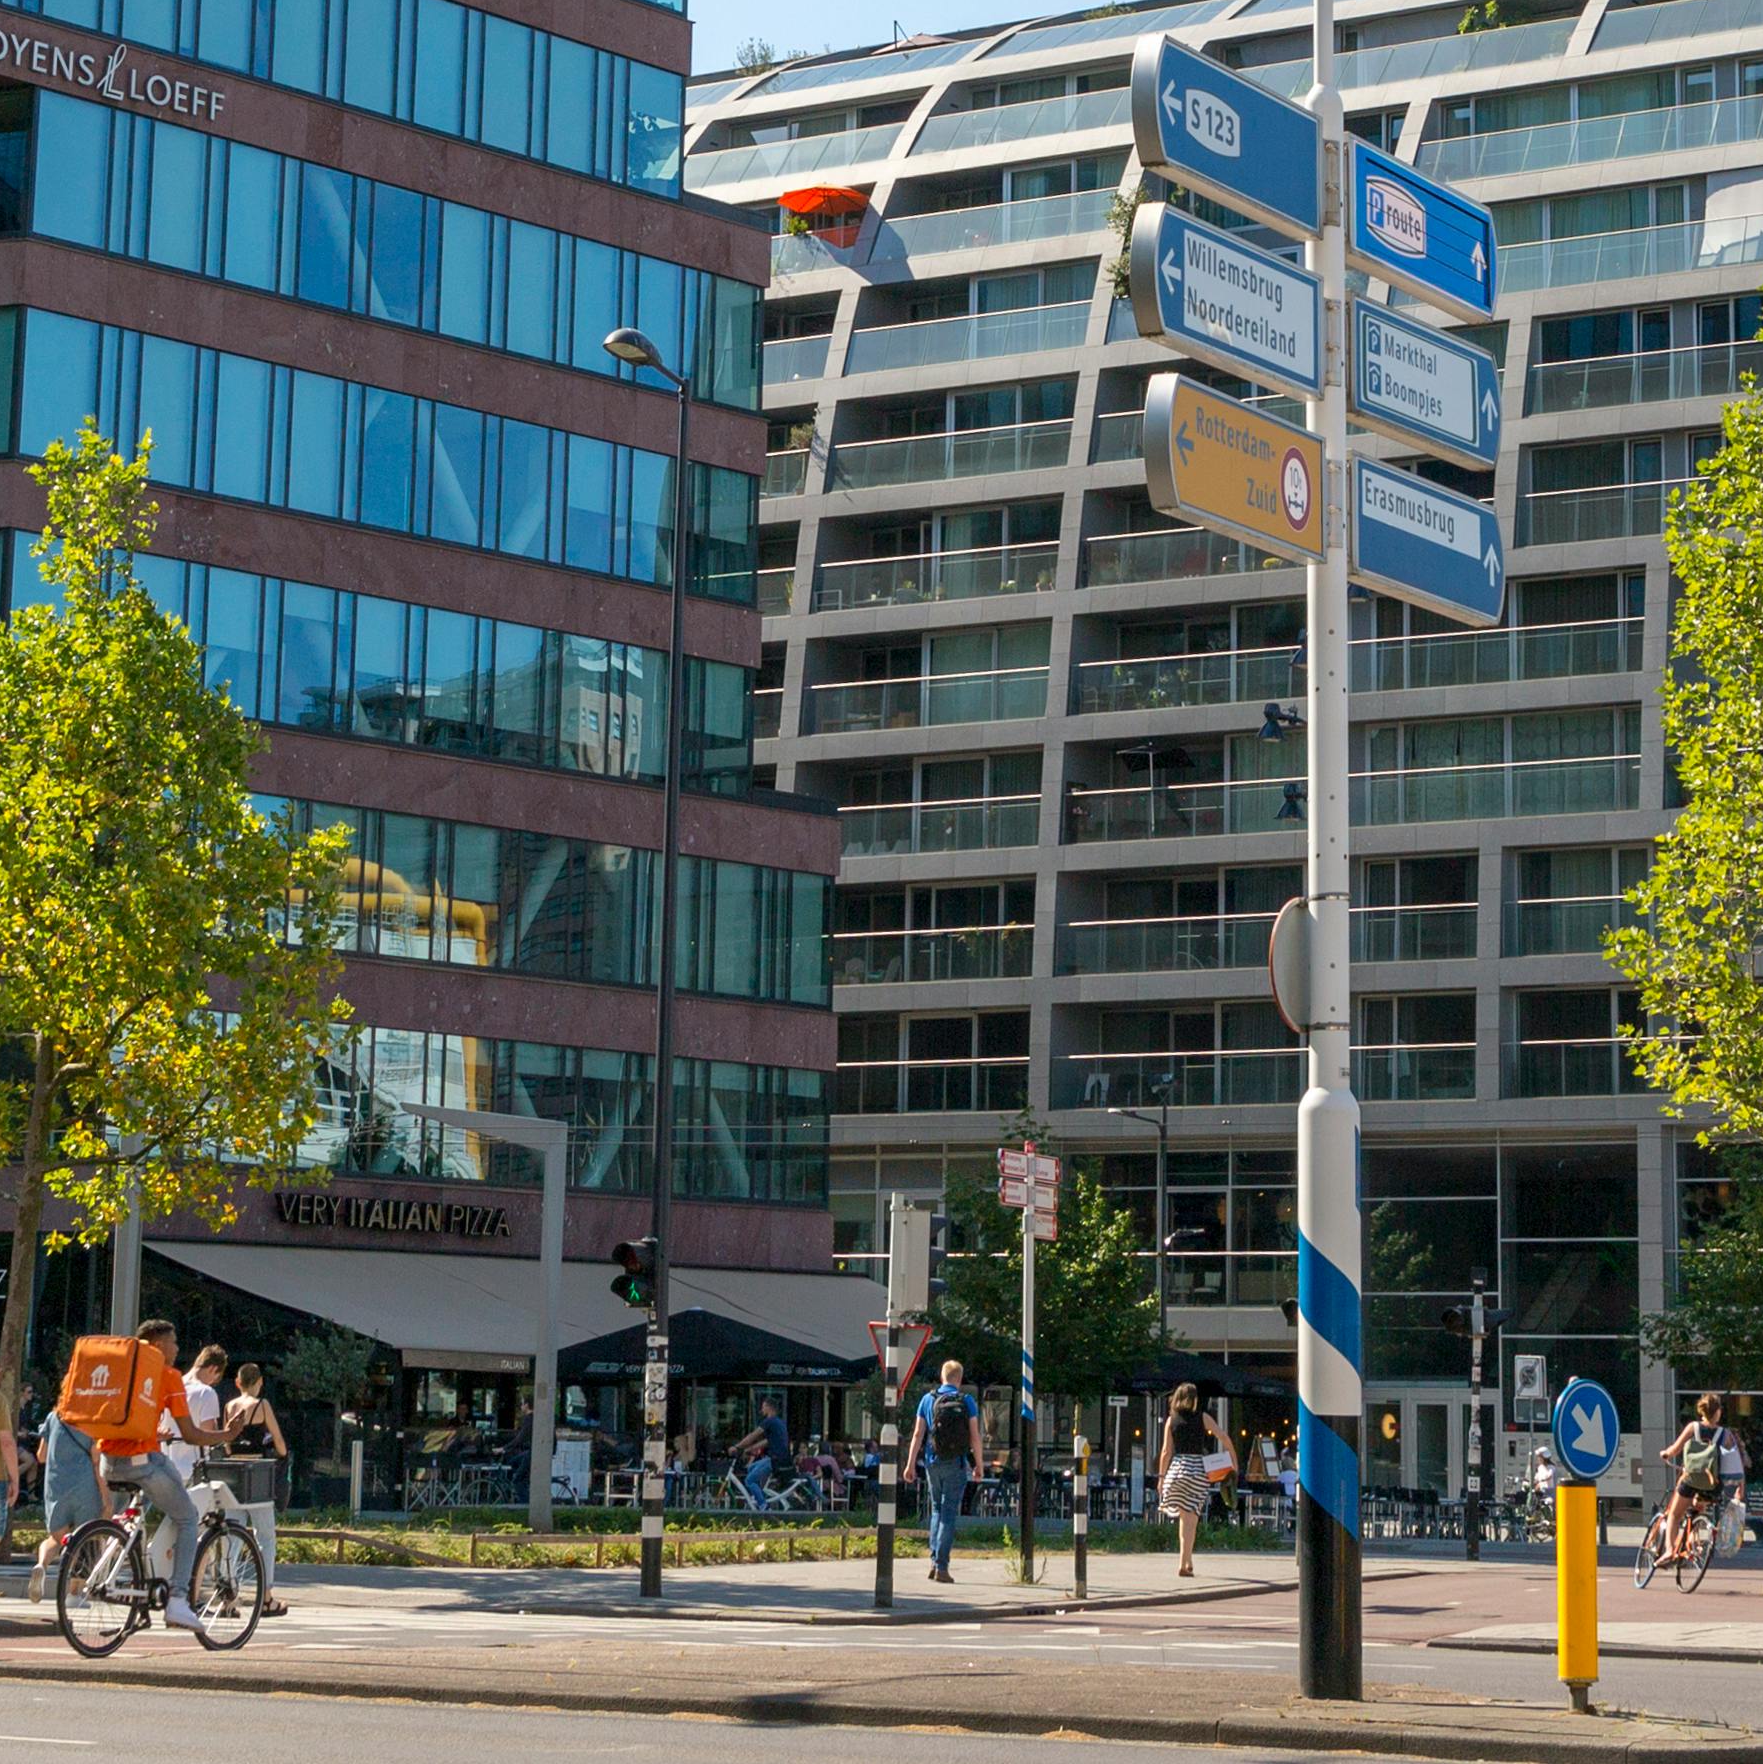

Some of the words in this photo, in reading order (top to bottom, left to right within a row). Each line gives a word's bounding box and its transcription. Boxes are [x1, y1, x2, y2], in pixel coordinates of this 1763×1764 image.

[130, 68, 226, 121] LOEFF
[1191, 98, 1201, 130] S
[1205, 105, 1235, 147] 123
[1387, 204, 1422, 242] route
[1187, 236, 1283, 313] Willemsbrug
[1187, 285, 1296, 358] Noordereiland
[1385, 333, 1437, 376] Markthal
[1385, 373, 1443, 418] Boompjes
[1196, 406, 1276, 462] Rotterdam-
[1246, 477, 1277, 515] Zuid
[1365, 476, 1455, 543] Erasmusbrug
[280, 1193, 343, 1226] VERY
[348, 1197, 443, 1233] ITALIAN
[449, 1204, 511, 1237] PIZZA
